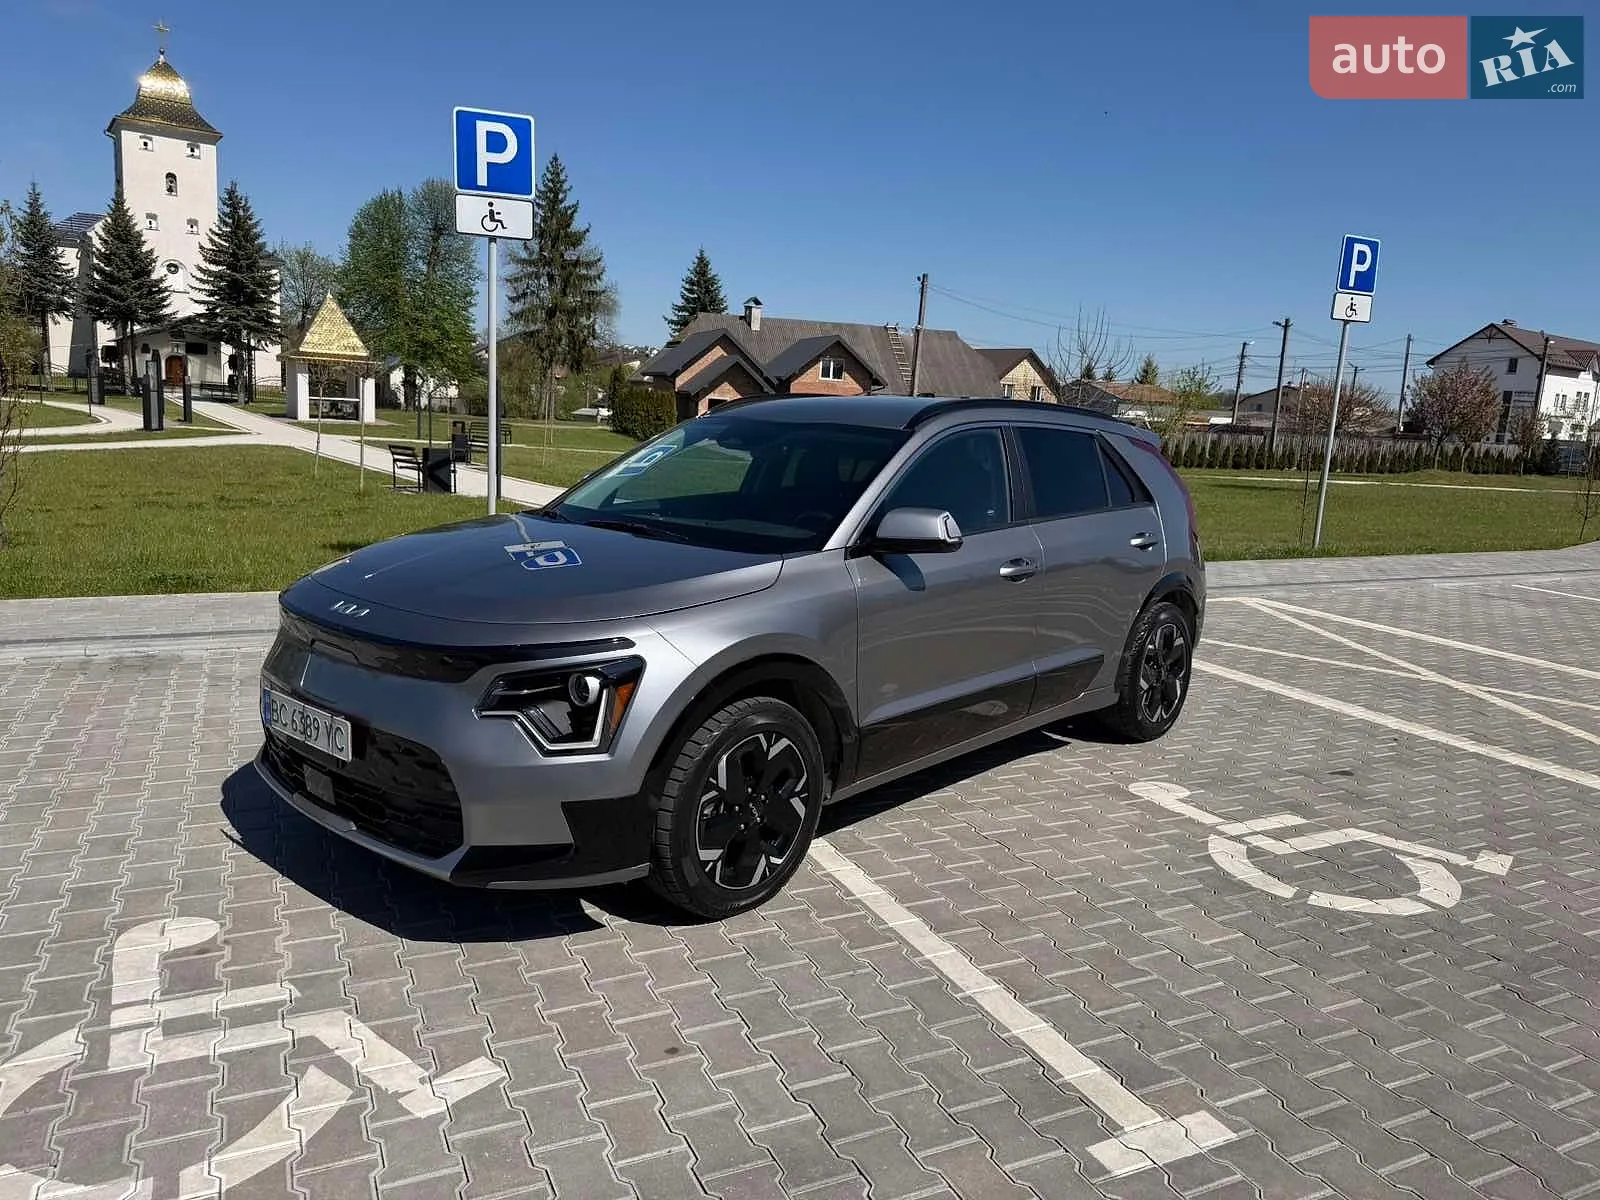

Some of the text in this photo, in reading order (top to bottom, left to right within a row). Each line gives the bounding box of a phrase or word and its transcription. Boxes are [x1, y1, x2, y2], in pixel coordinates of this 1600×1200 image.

[476, 120, 518, 187] P
[1349, 243, 1372, 287] P
[271, 699, 345, 752] BC 6389 YC
